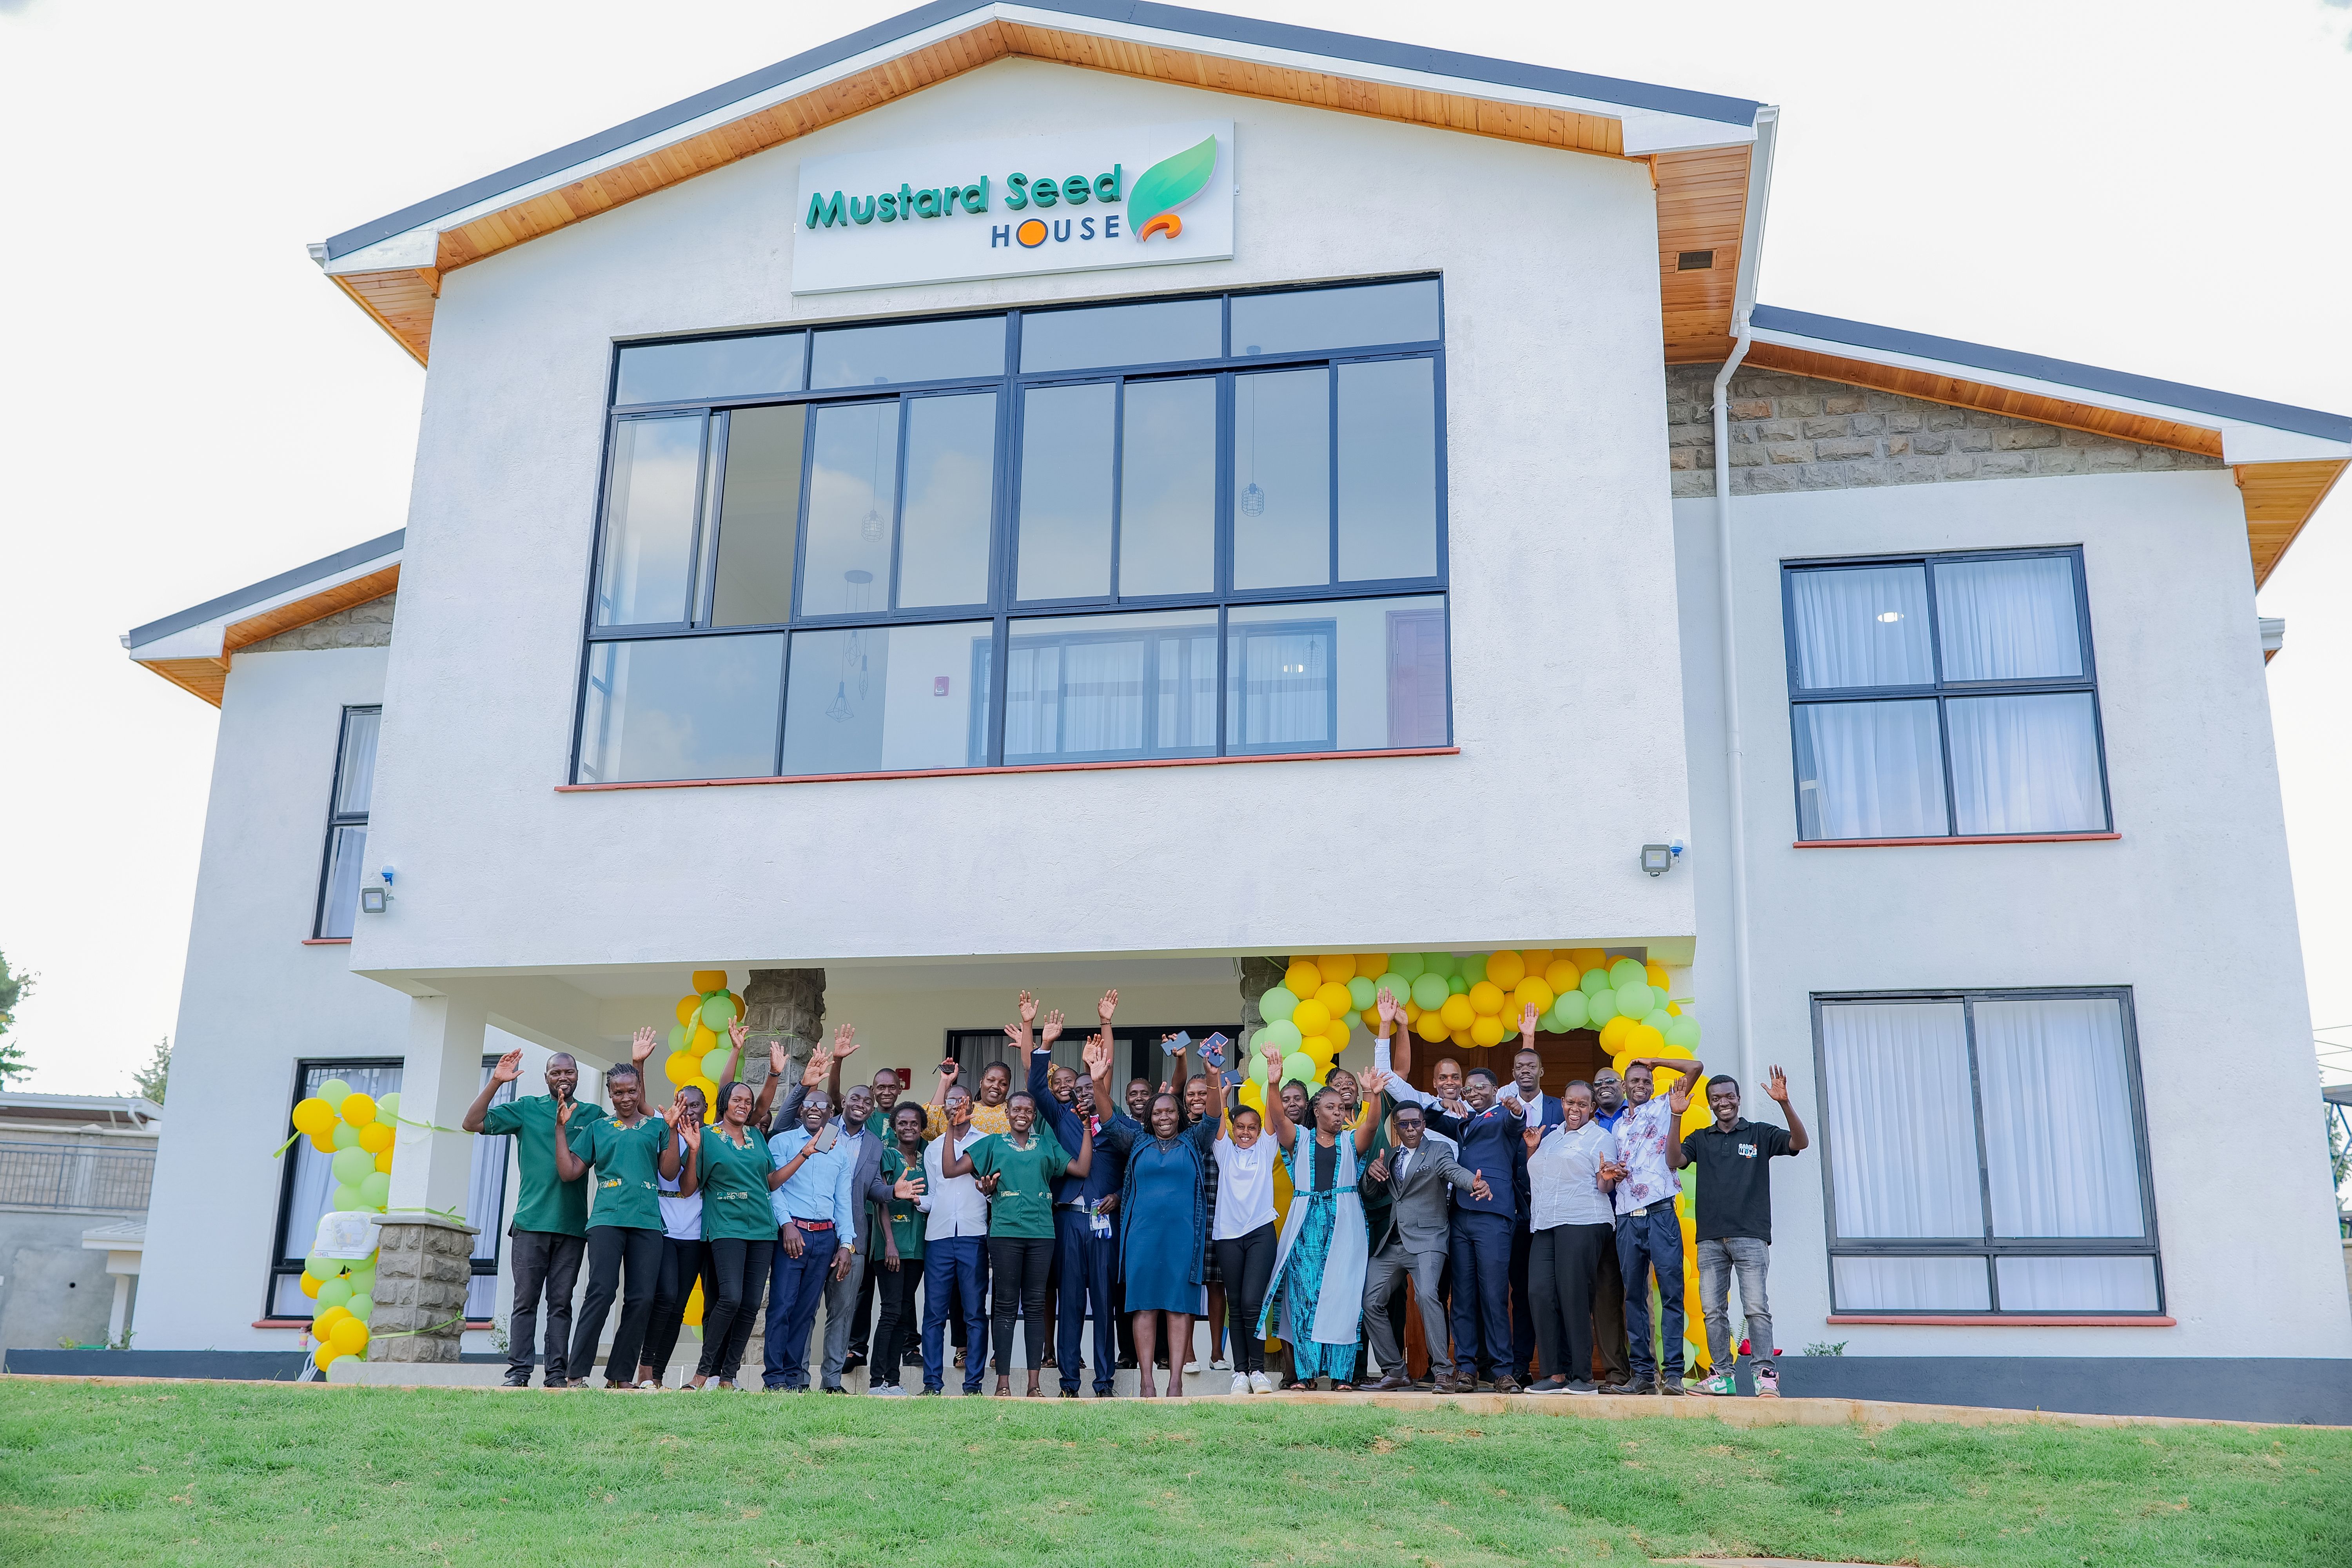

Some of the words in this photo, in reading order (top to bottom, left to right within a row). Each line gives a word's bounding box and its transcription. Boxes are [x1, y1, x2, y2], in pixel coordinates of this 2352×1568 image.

[805, 175, 990, 229] Mustard
[1005, 163, 1122, 211] Seed
[991, 214, 1120, 249] HOUSE
[1739, 1147, 1757, 1156] HOPE
